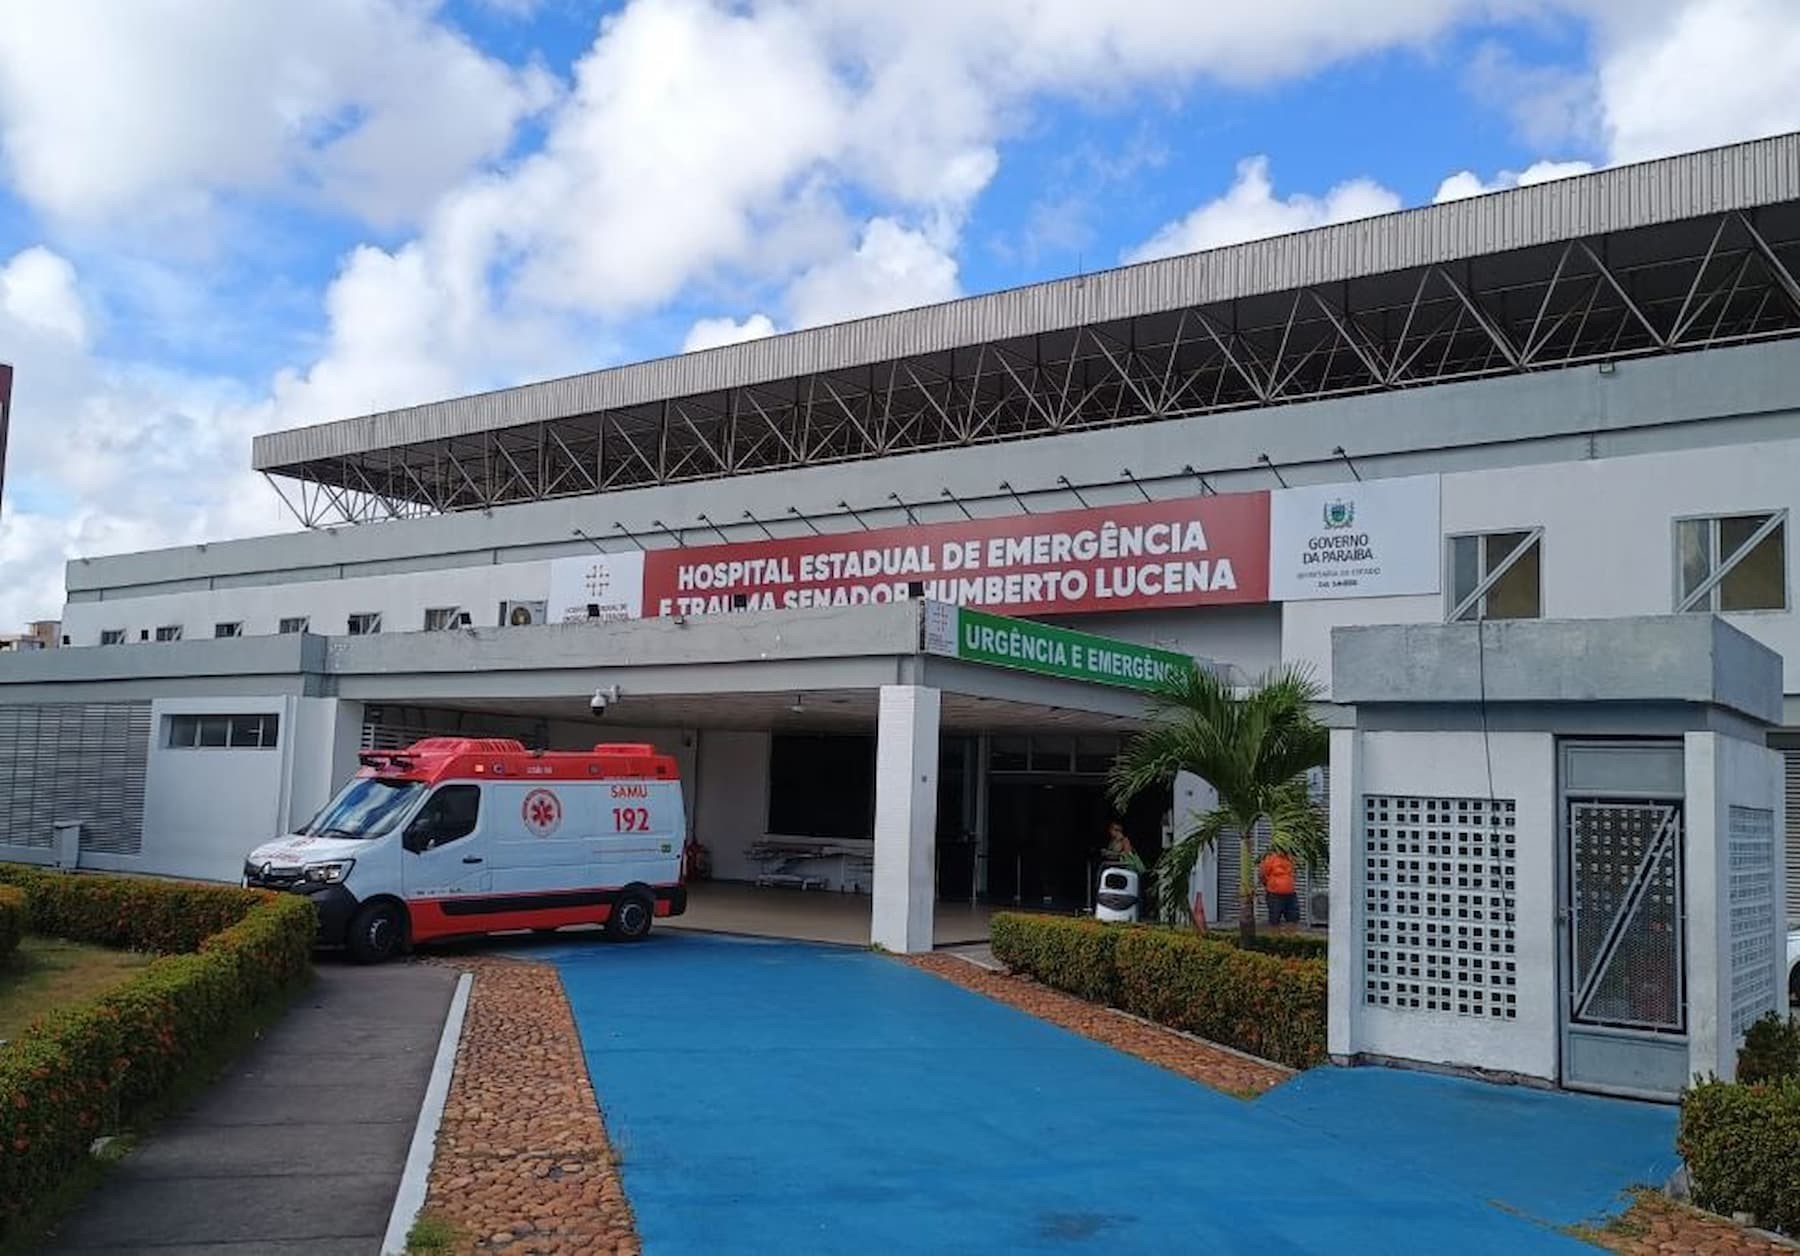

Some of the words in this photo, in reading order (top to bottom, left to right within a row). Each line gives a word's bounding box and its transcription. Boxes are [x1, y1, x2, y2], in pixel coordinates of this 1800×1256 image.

[1308, 534, 1369, 550] GOVERNO
[678, 560, 794, 590] HOSPITAL
[800, 546, 935, 582] ESTADUAL
[942, 540, 981, 571] DE
[988, 521, 1208, 568] EMERGÊNCIA
[1303, 553, 1320, 564] DA
[659, 598, 672, 616] E
[1096, 559, 1237, 597] LUCENA
[965, 623, 1067, 667] URGÊNCIA
[1072, 645, 1083, 669] E
[611, 785, 647, 798] SAMU
[613, 808, 649, 831] 192
